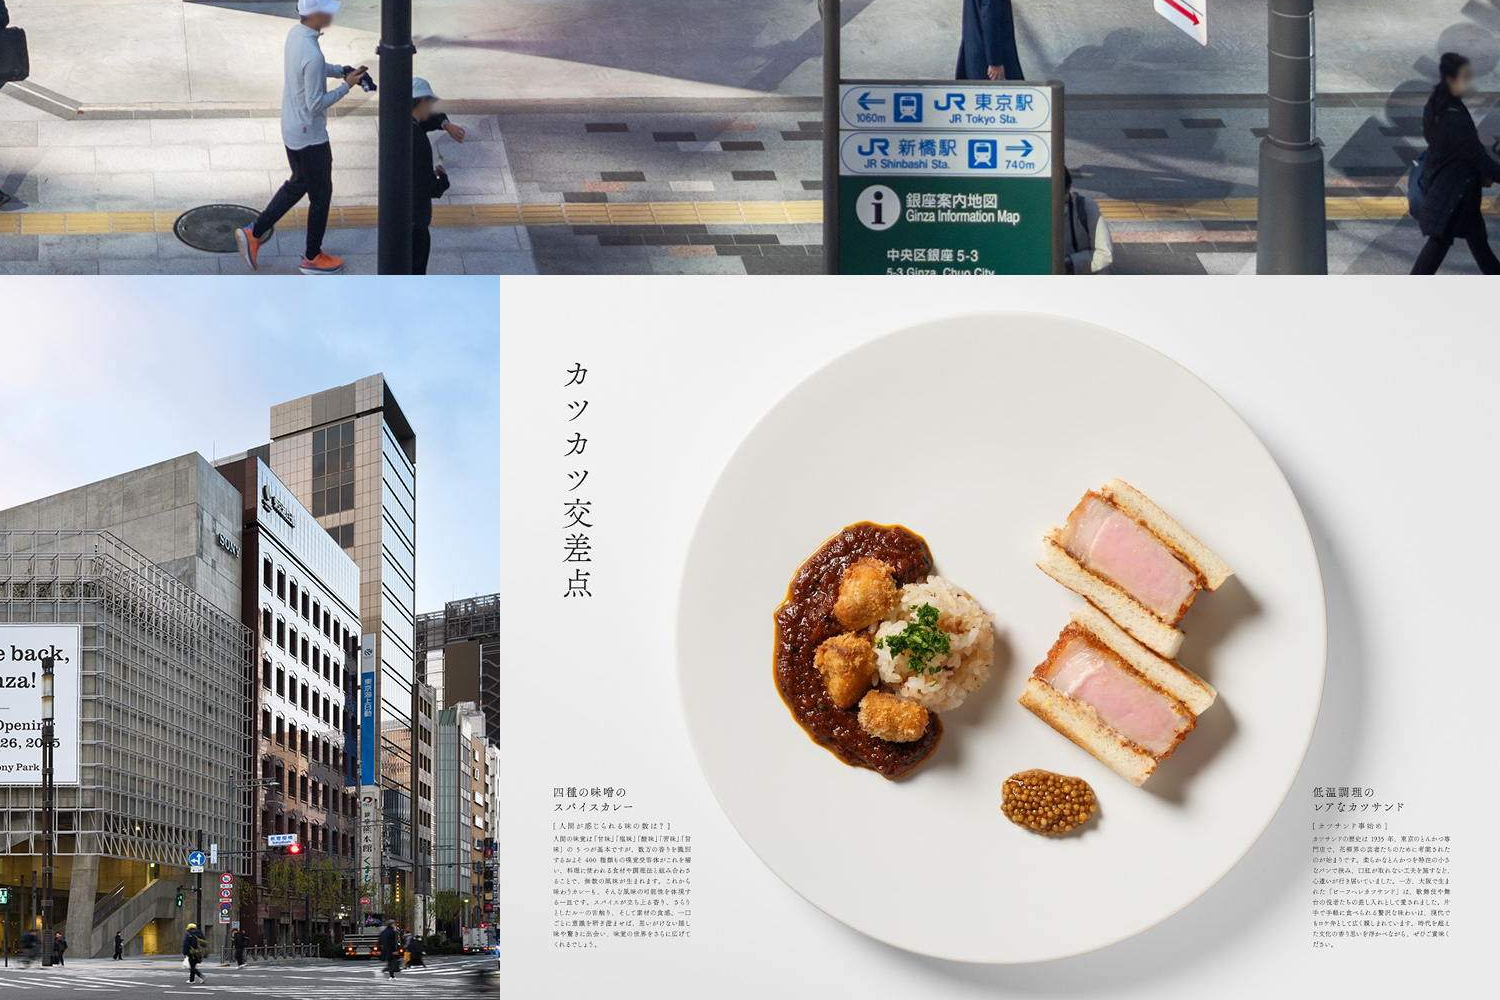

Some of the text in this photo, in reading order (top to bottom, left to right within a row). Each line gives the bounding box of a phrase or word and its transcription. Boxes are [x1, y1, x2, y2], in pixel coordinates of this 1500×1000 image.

[933, 93, 1034, 112] JR 東京駅
[856, 112, 1019, 125] 1060m JR Tokyo Sta.
[857, 138, 958, 157] JR 新橋駅
[864, 159, 1035, 170] JR Shinbashi Sta. 740m
[906, 192, 998, 209] 銀座案内地図
[906, 209, 1021, 225] Ginza Information Map
[886, 249, 979, 262] 中央区銀座 5-3
[218, 532, 241, 559] SONY
[10, 644, 70, 664] back,
[0, 737, 23, 749] 26,
[25, 737, 61, 748] 205
[15, 762, 41, 772] Park
